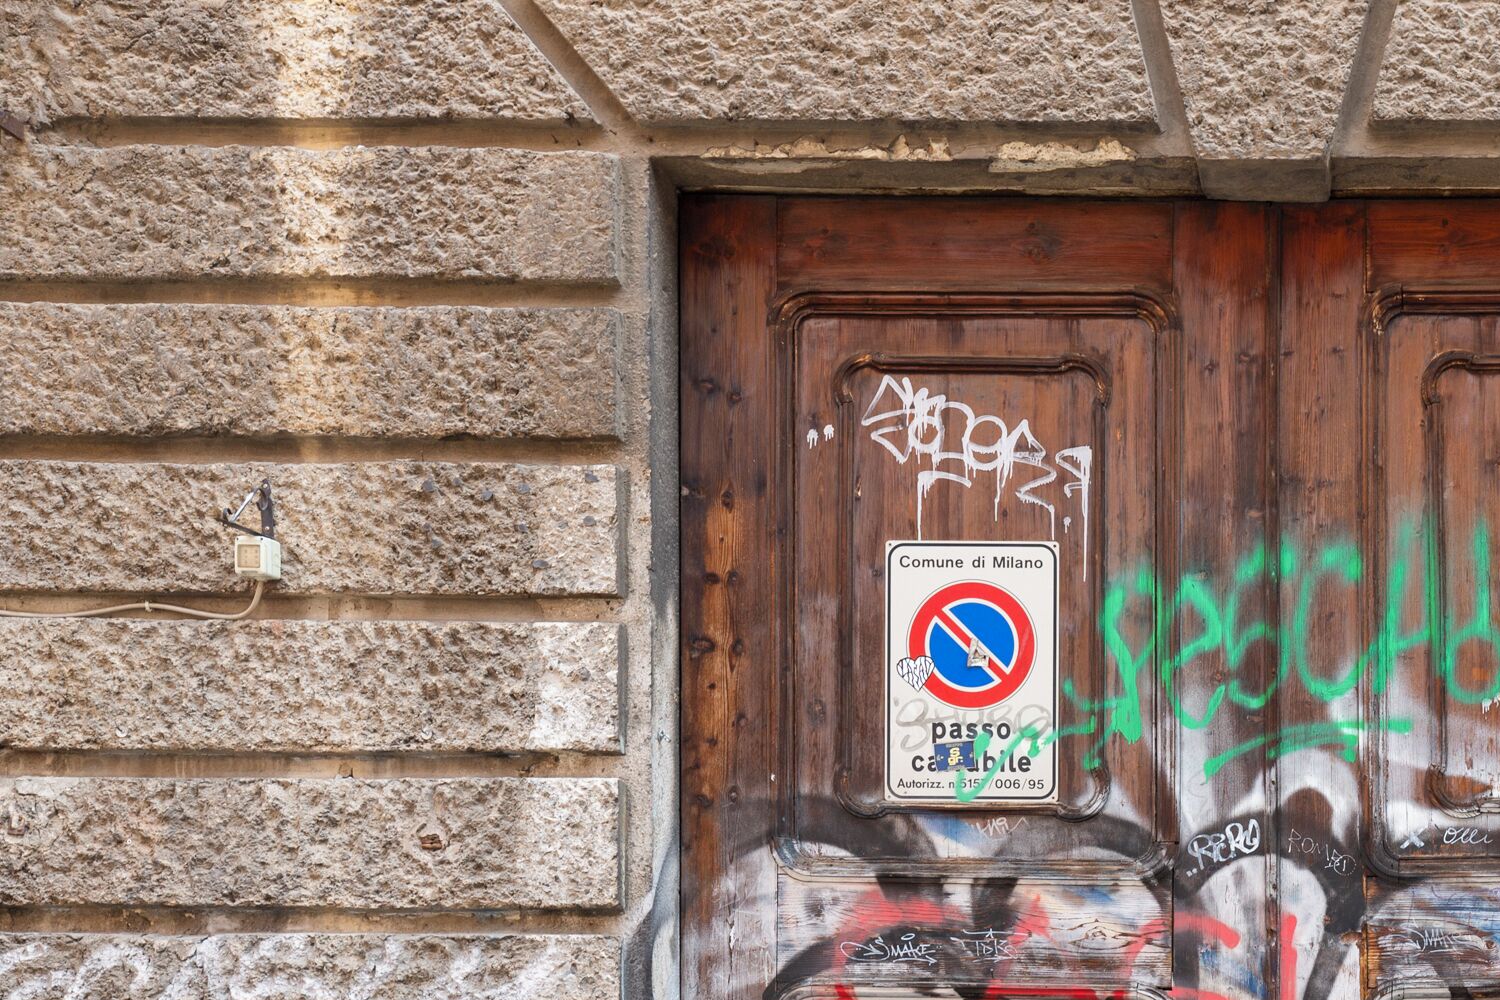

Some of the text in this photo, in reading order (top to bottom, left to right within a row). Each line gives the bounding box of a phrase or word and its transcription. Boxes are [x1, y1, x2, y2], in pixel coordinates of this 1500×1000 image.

[899, 555, 1044, 569] Comune di Milano
[931, 722, 1012, 744] passo
[896, 777, 945, 790] Autorizz.
